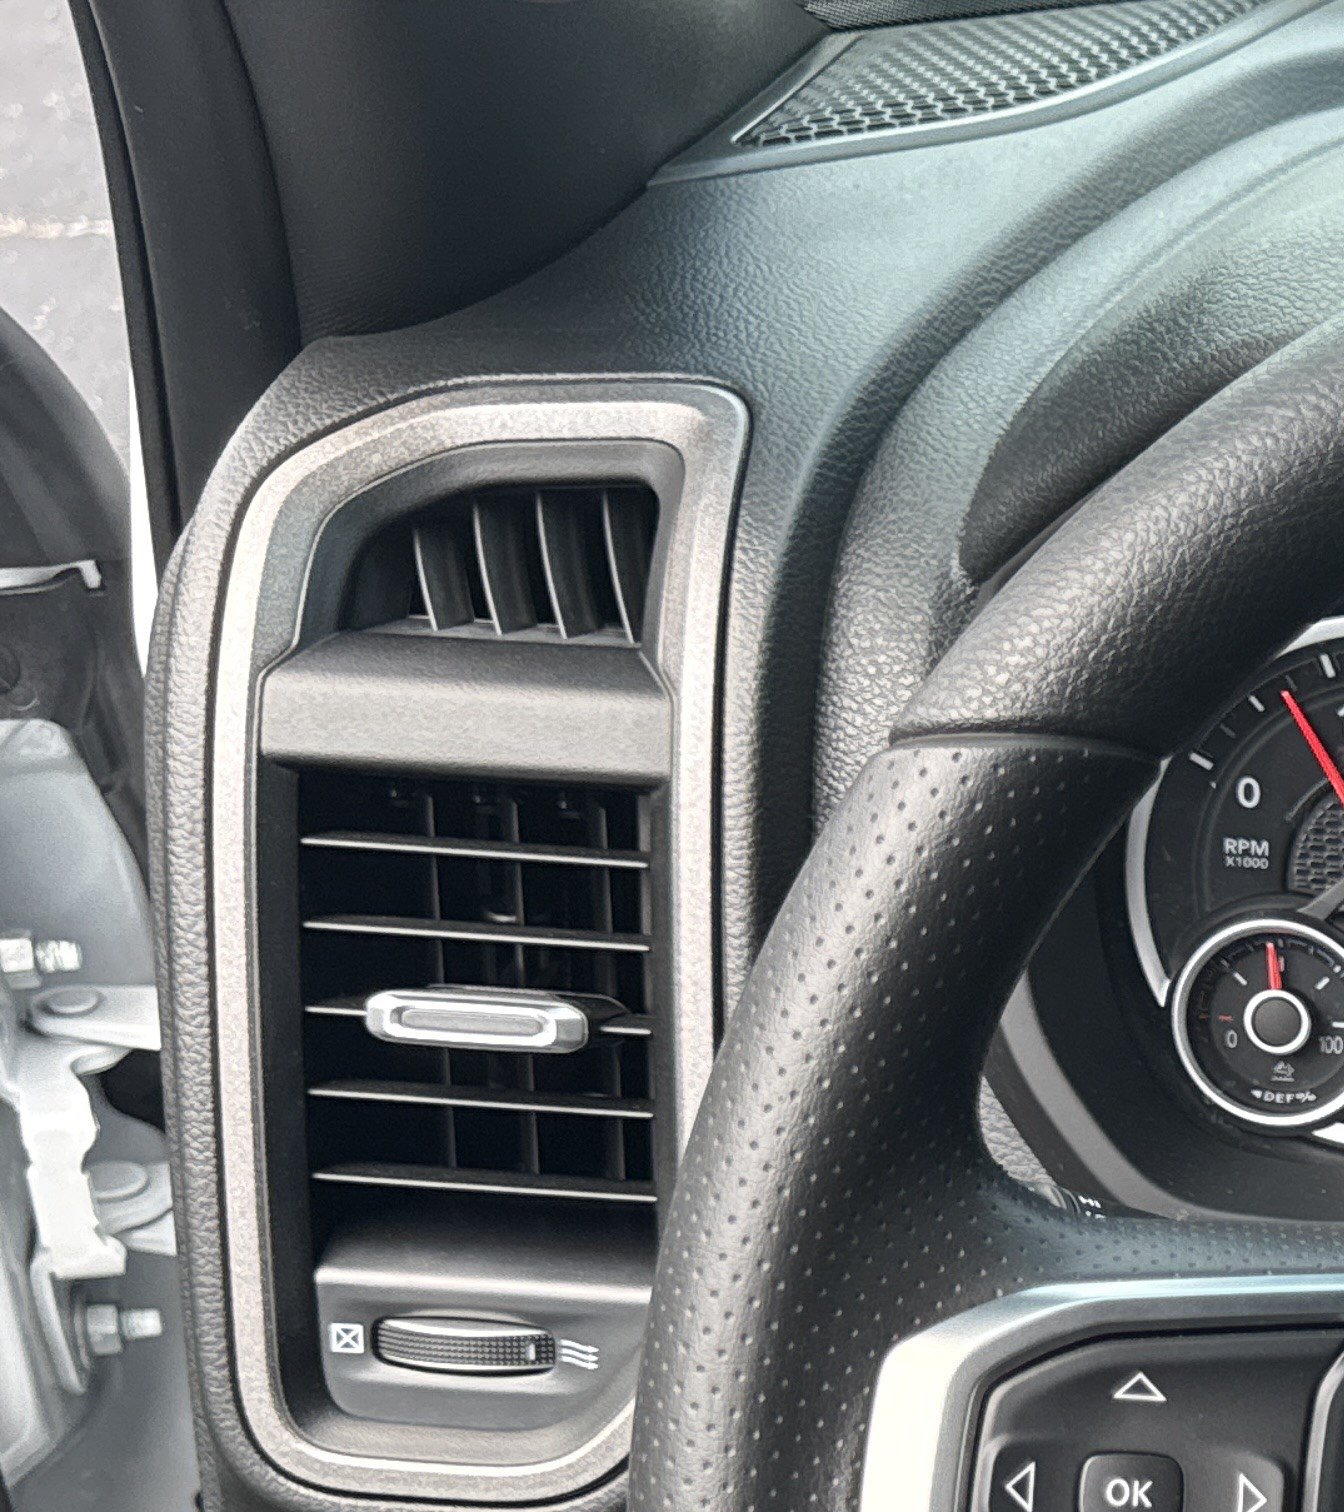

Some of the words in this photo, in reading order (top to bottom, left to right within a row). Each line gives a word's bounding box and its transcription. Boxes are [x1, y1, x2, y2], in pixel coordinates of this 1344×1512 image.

[1236, 776, 1261, 808] 0
[1224, 838, 1269, 856] RPM
[1226, 1031, 1238, 1048] 0
[1319, 1035, 1344, 1055] 100
[1105, 1478, 1153, 1508] OK
